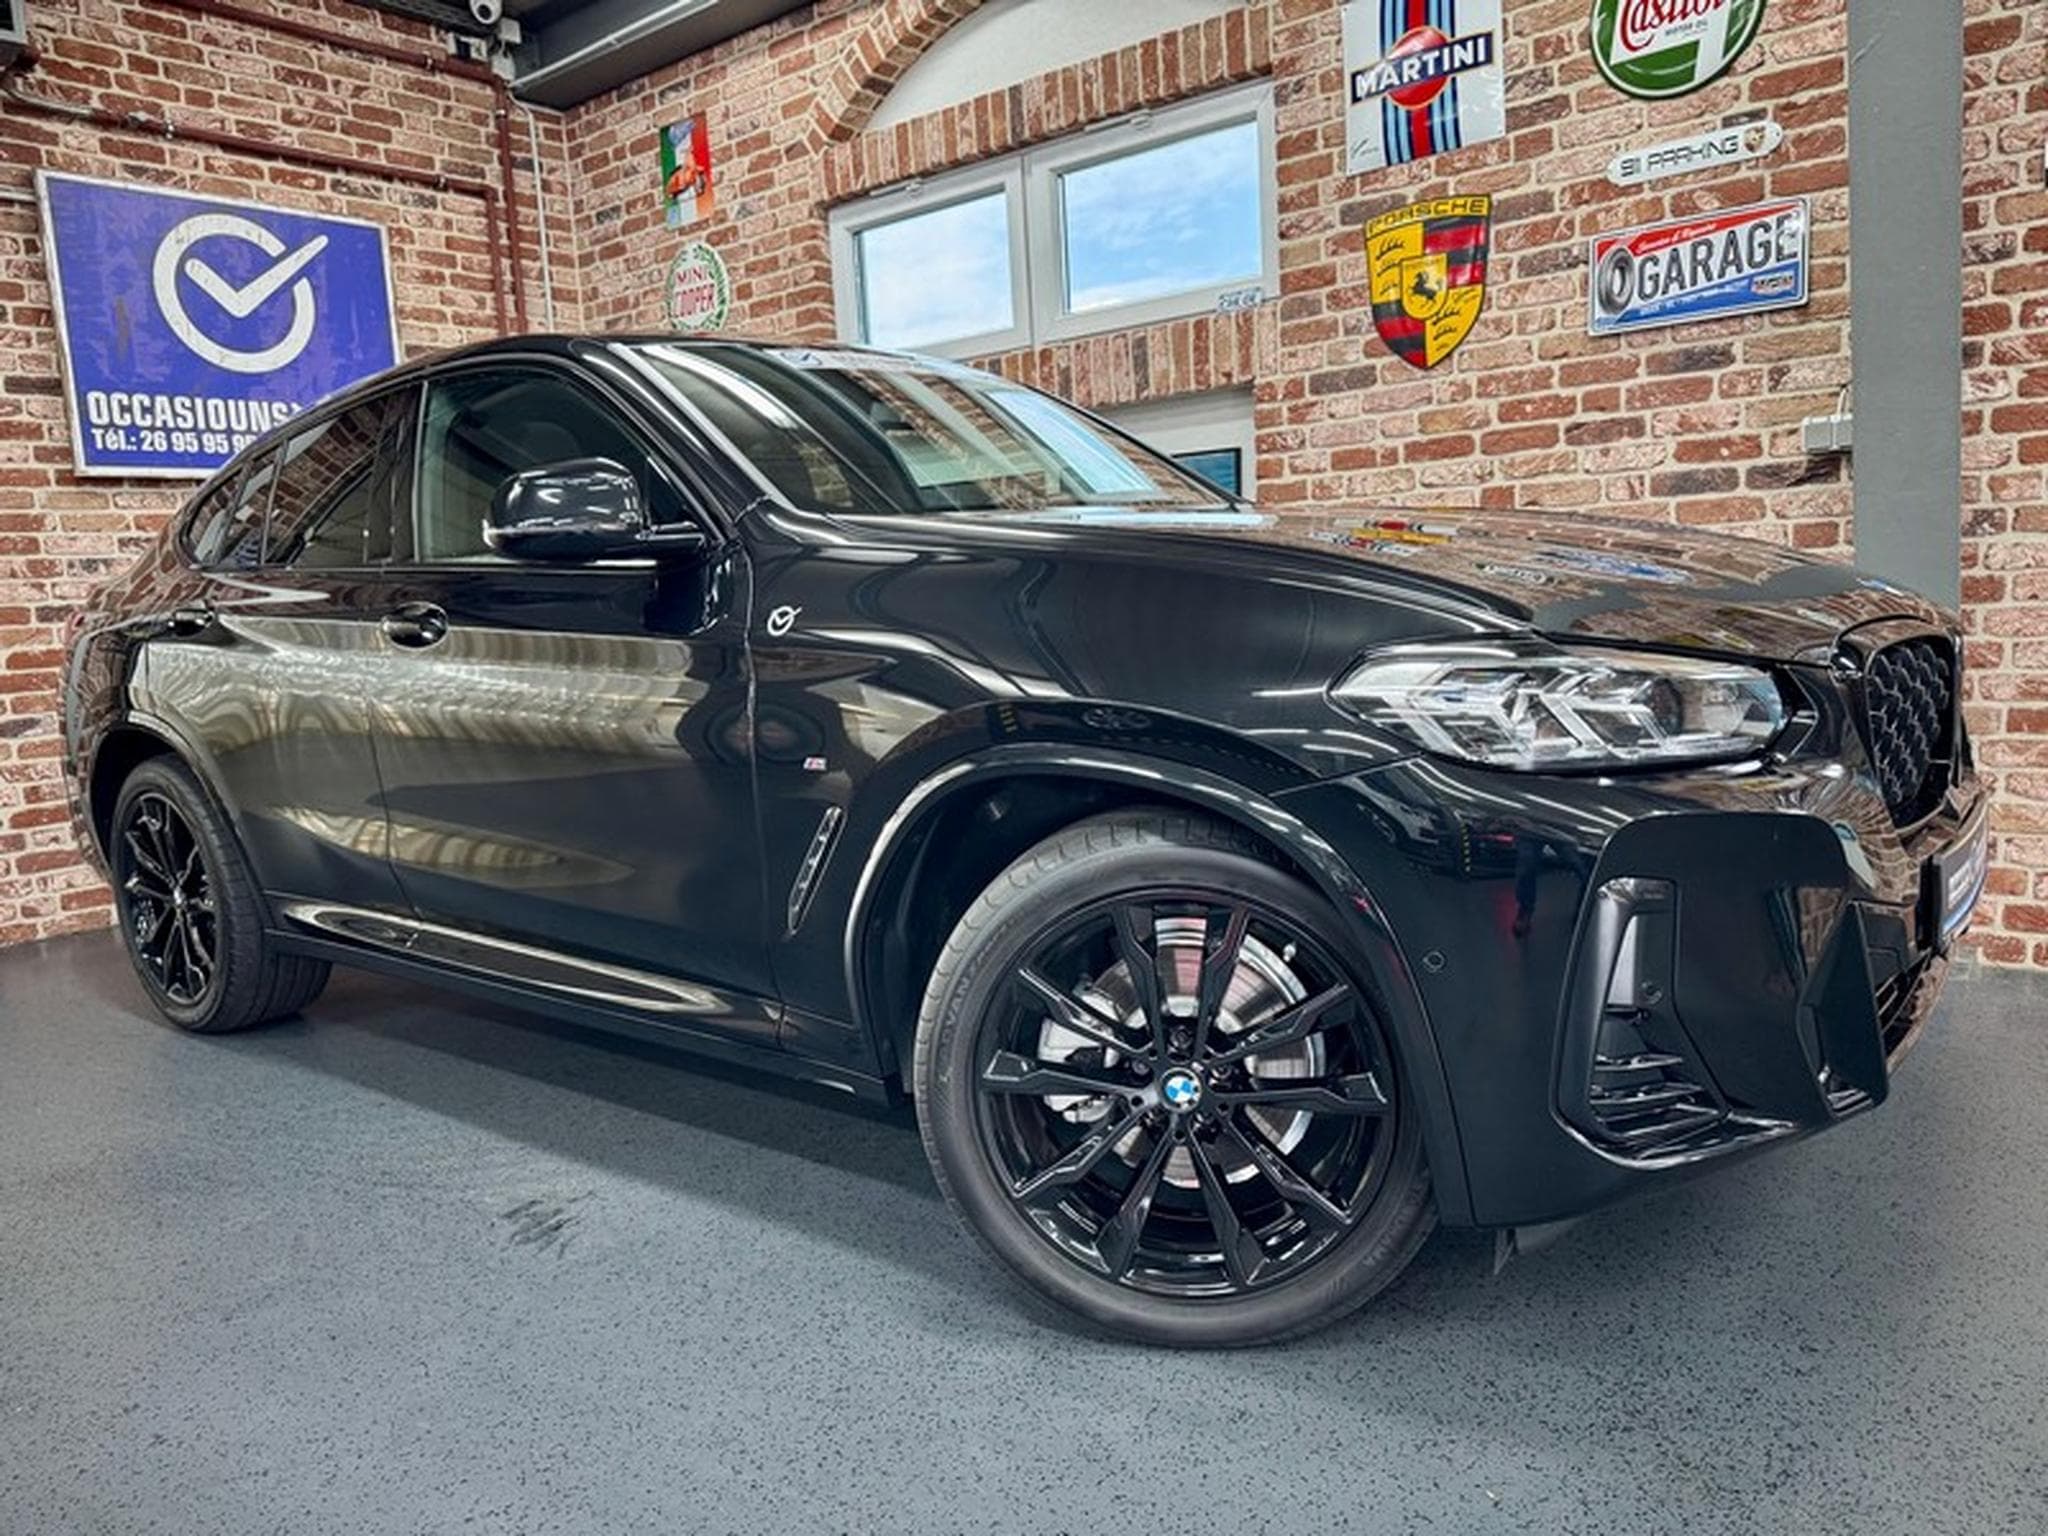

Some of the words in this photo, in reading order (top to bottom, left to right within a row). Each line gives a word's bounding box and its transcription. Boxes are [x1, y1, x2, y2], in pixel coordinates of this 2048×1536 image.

[1355, 37, 1487, 99] MARTINI
[1368, 199, 1485, 234] PORSCHE
[1637, 213, 1799, 301] GARAGE
[91, 427, 137, 452] Tél.:
[139, 429, 168, 452] 26
[171, 431, 199, 454] 95
[201, 432, 230, 455] 95
